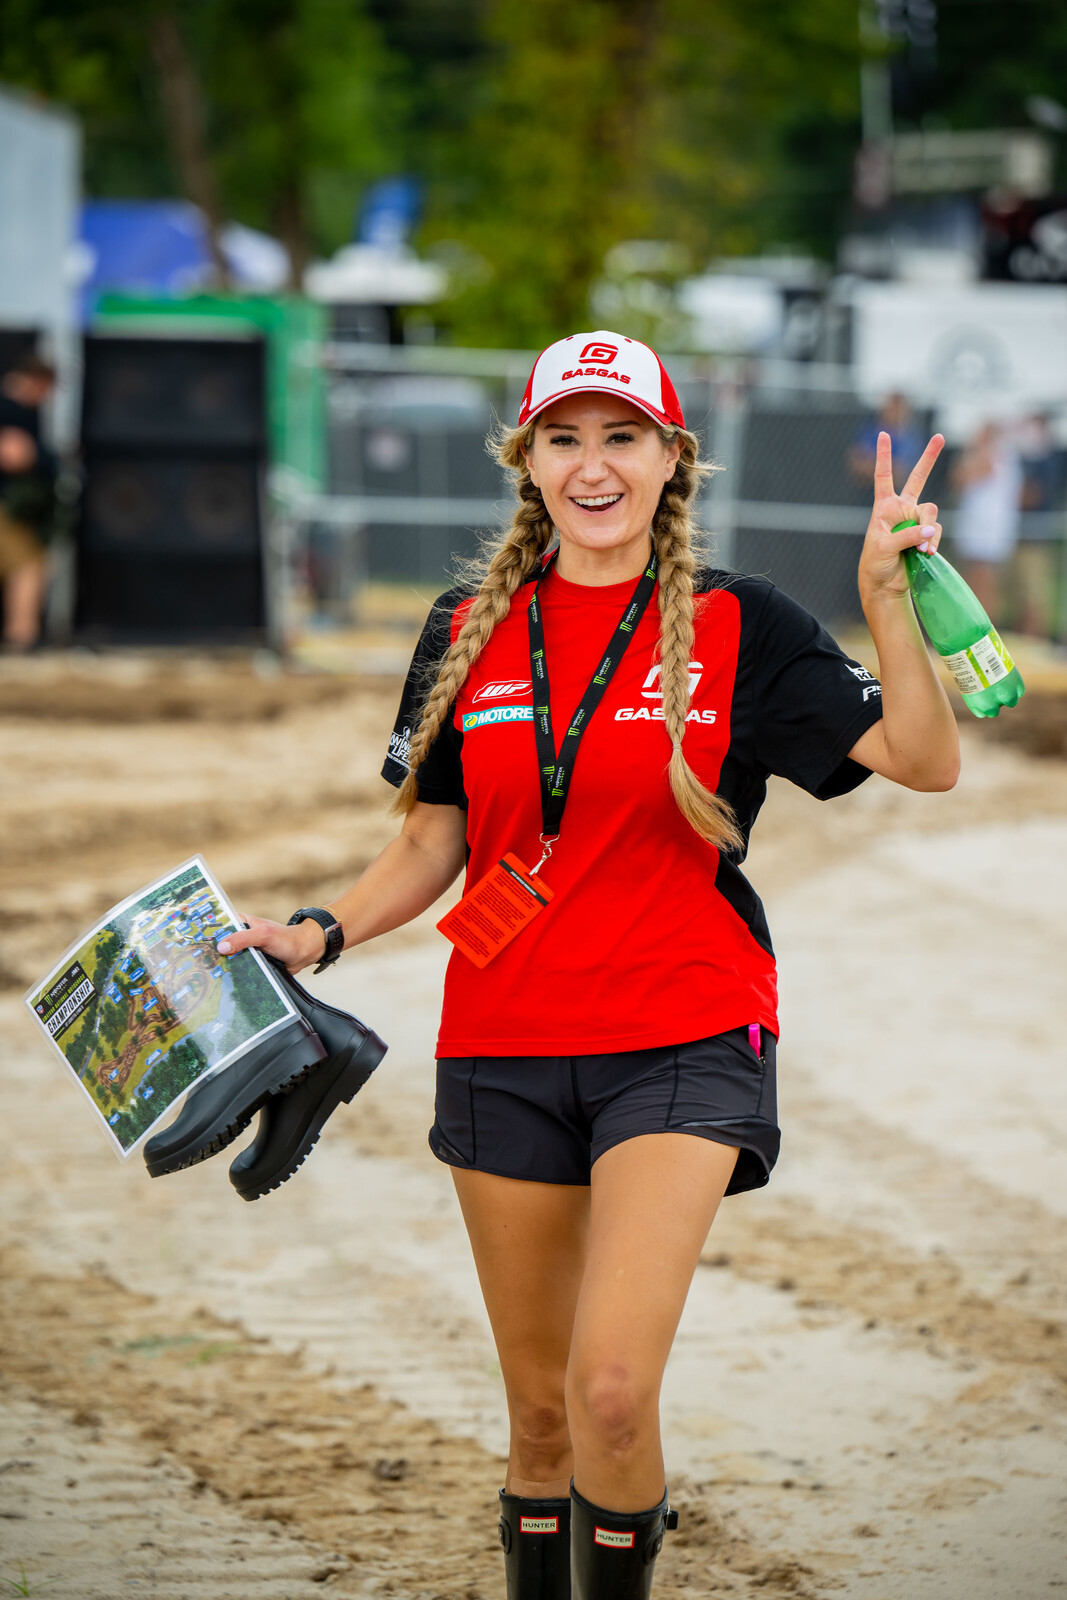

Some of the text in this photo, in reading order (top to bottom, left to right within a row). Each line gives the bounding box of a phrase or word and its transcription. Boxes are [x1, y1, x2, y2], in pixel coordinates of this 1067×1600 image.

[562, 368, 631, 384] GASGAS
[479, 683, 530, 697] WP
[614, 707, 717, 724] GASAS
[47, 981, 90, 1034] CHAMPIONSHIP
[597, 1533, 631, 1543] HUNTER
